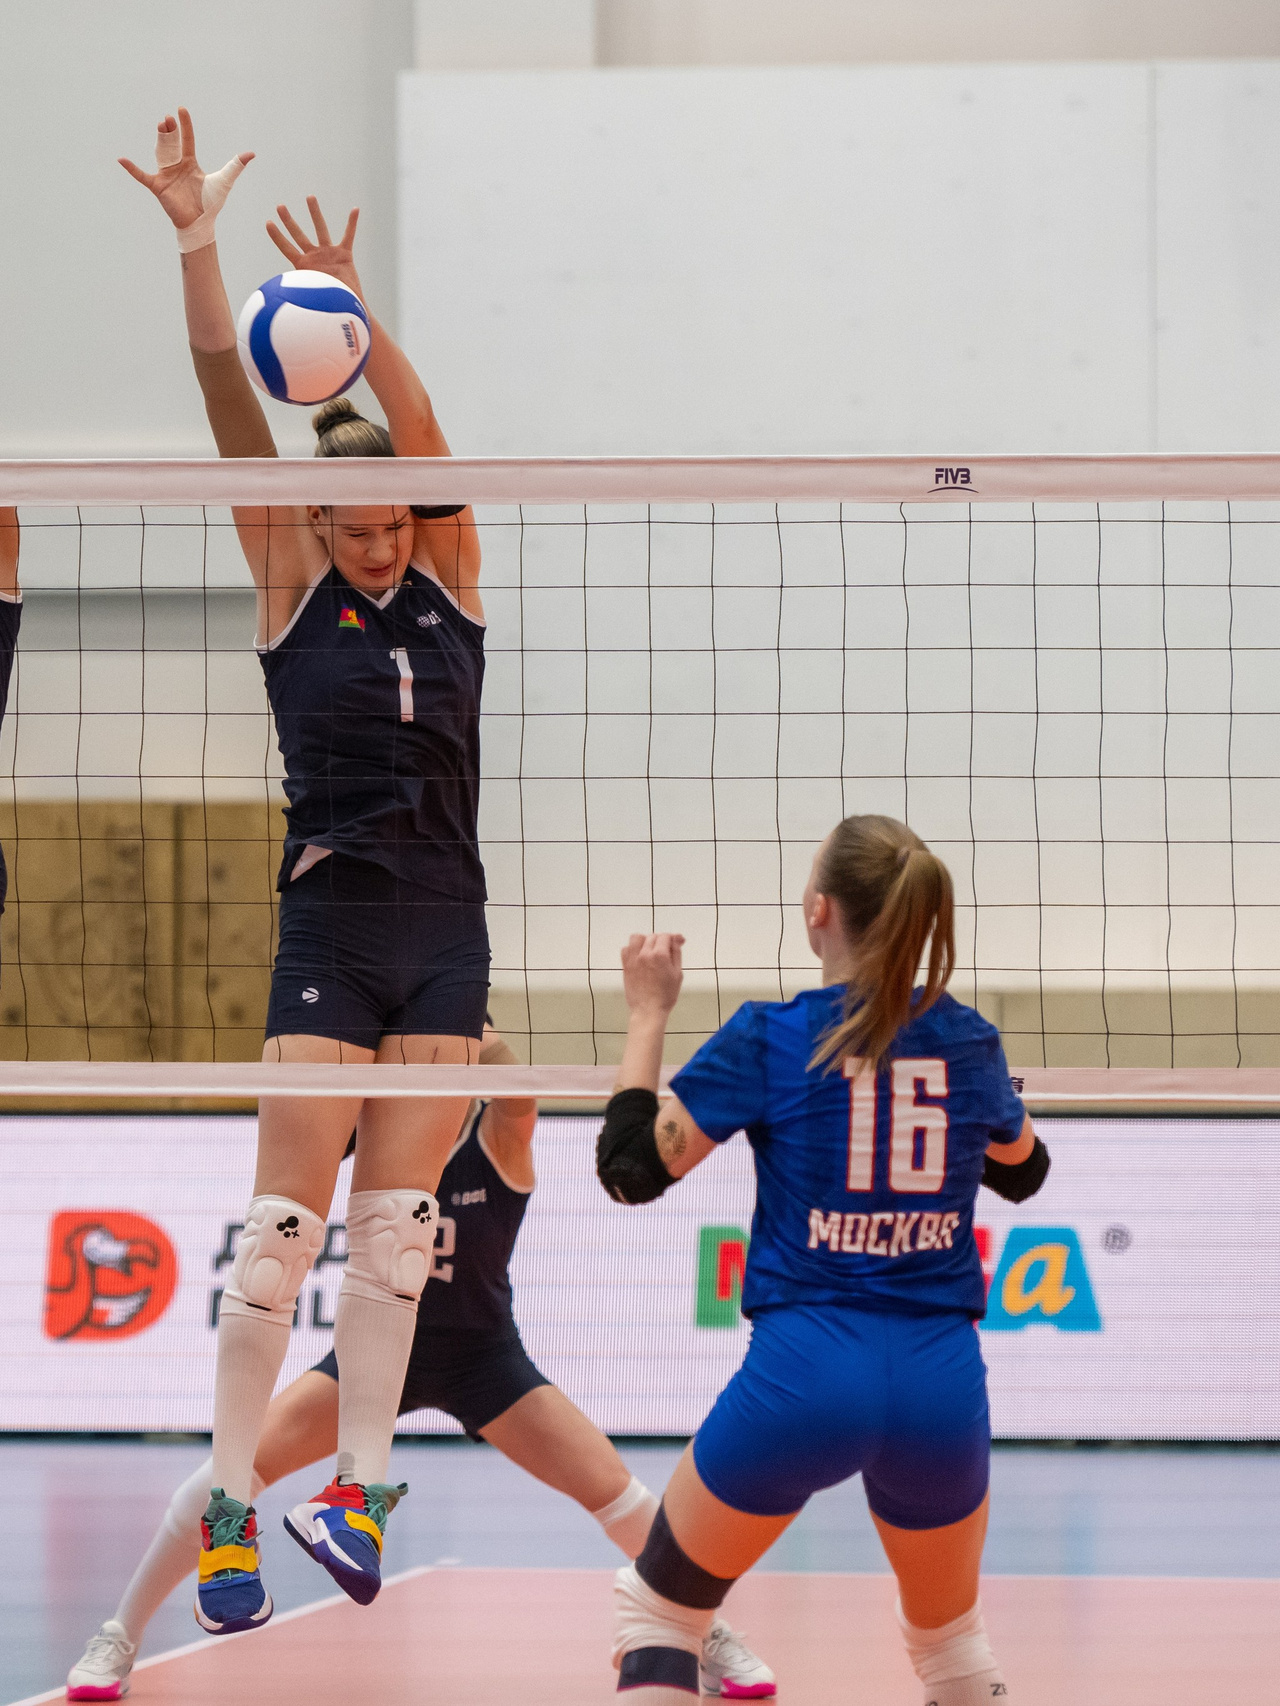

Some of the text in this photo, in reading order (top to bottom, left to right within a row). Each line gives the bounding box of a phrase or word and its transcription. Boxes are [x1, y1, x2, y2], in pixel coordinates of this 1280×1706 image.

[934, 467, 972, 484] FIVB
[389, 647, 414, 722] 1
[841, 1055, 950, 1195] 16
